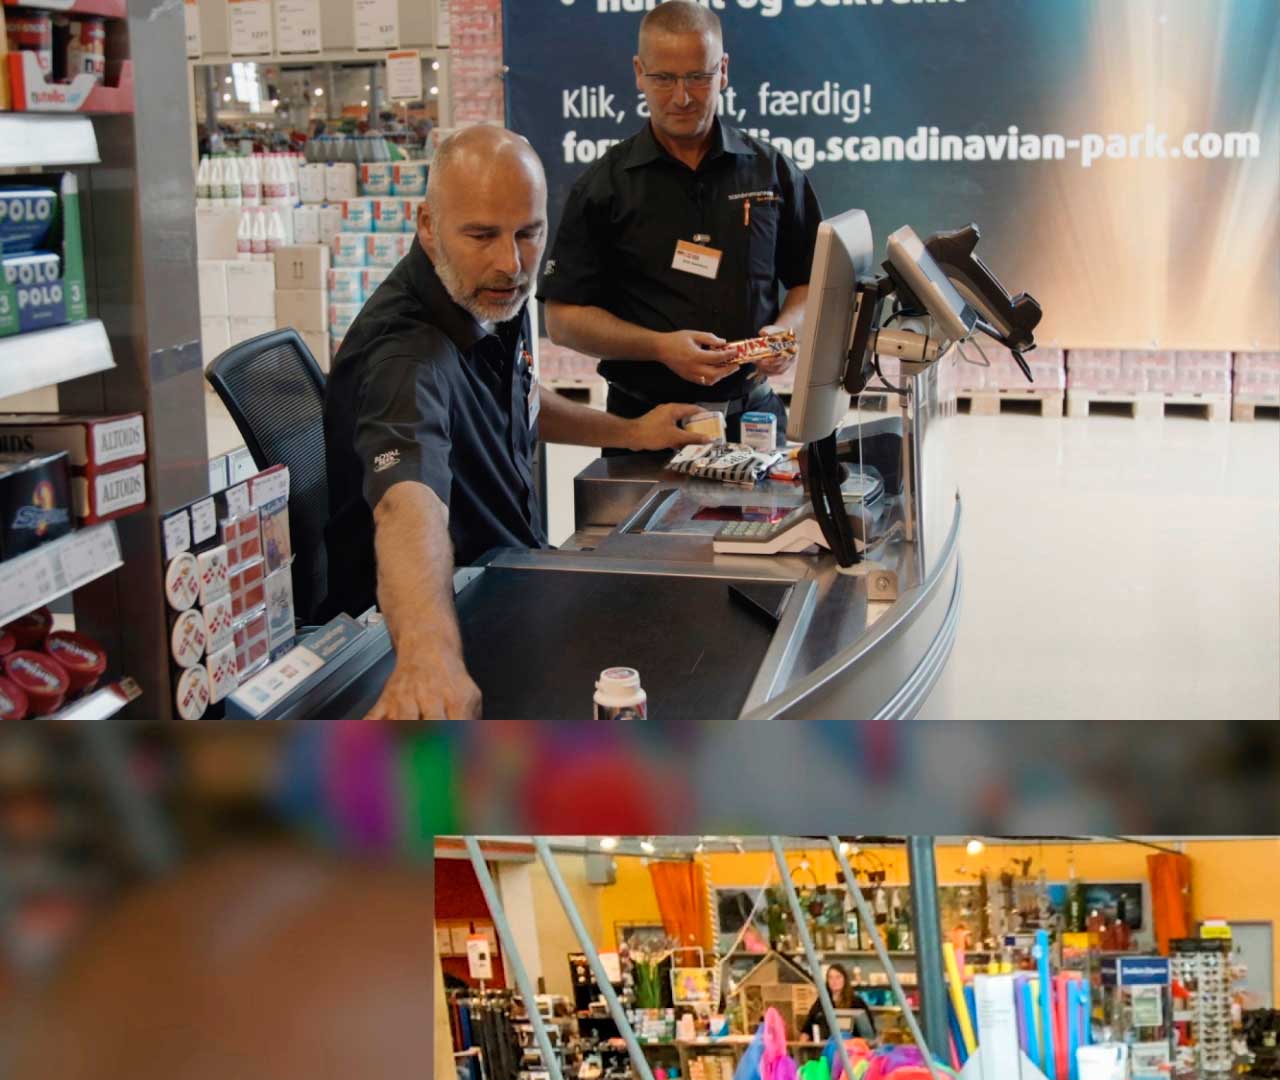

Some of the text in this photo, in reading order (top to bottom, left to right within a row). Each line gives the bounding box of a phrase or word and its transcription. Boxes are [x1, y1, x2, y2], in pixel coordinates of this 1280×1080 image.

[562, 86, 625, 124] Klik,
[758, 80, 872, 123] færdig!
[17, 284, 63, 309] POLO
[70, 284, 81, 302] 3
[100, 424, 141, 451] ALTOIDS
[102, 474, 142, 502] ALTOIDS
